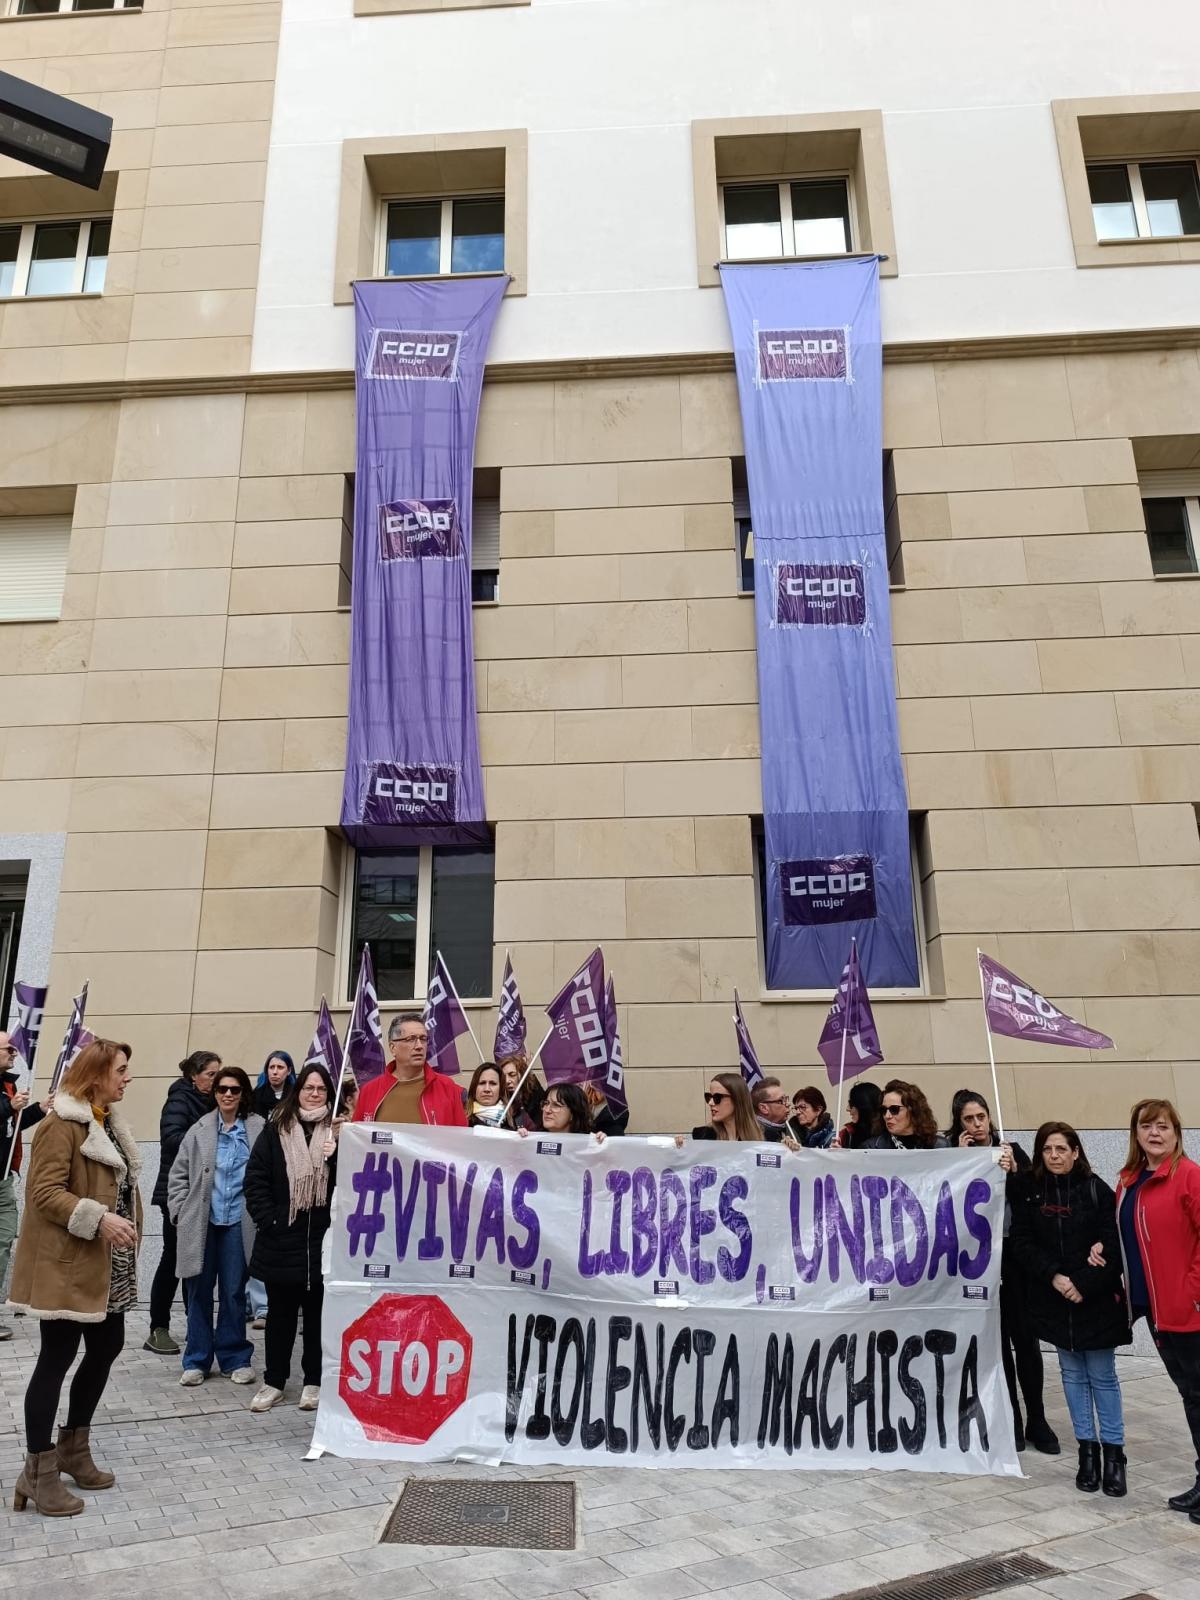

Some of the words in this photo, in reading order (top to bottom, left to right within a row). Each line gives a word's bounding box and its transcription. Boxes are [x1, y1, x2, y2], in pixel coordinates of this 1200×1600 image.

[382, 341, 450, 357] CCOO
[767, 340, 838, 355] CCOO
[399, 357, 426, 366] mujer
[788, 357, 817, 366] mujer
[386, 511, 451, 533] CCOO
[406, 531, 433, 543] mujer
[787, 578, 856, 597] CCOO
[807, 600, 837, 611] mujer
[375, 777, 448, 802] CCOO
[395, 802, 426, 814] mujer
[789, 872, 866, 896] CCOO
[812, 897, 845, 909] mujer
[347, 1152, 551, 1290] #VIVAS,
[578, 1166, 767, 1304] LIBRES,
[790, 1174, 992, 1287] UNIDAS
[348, 1340, 465, 1396] STOP
[504, 1313, 740, 1453] VIOLENCIA
[757, 1329, 990, 1456] MACHISTA
